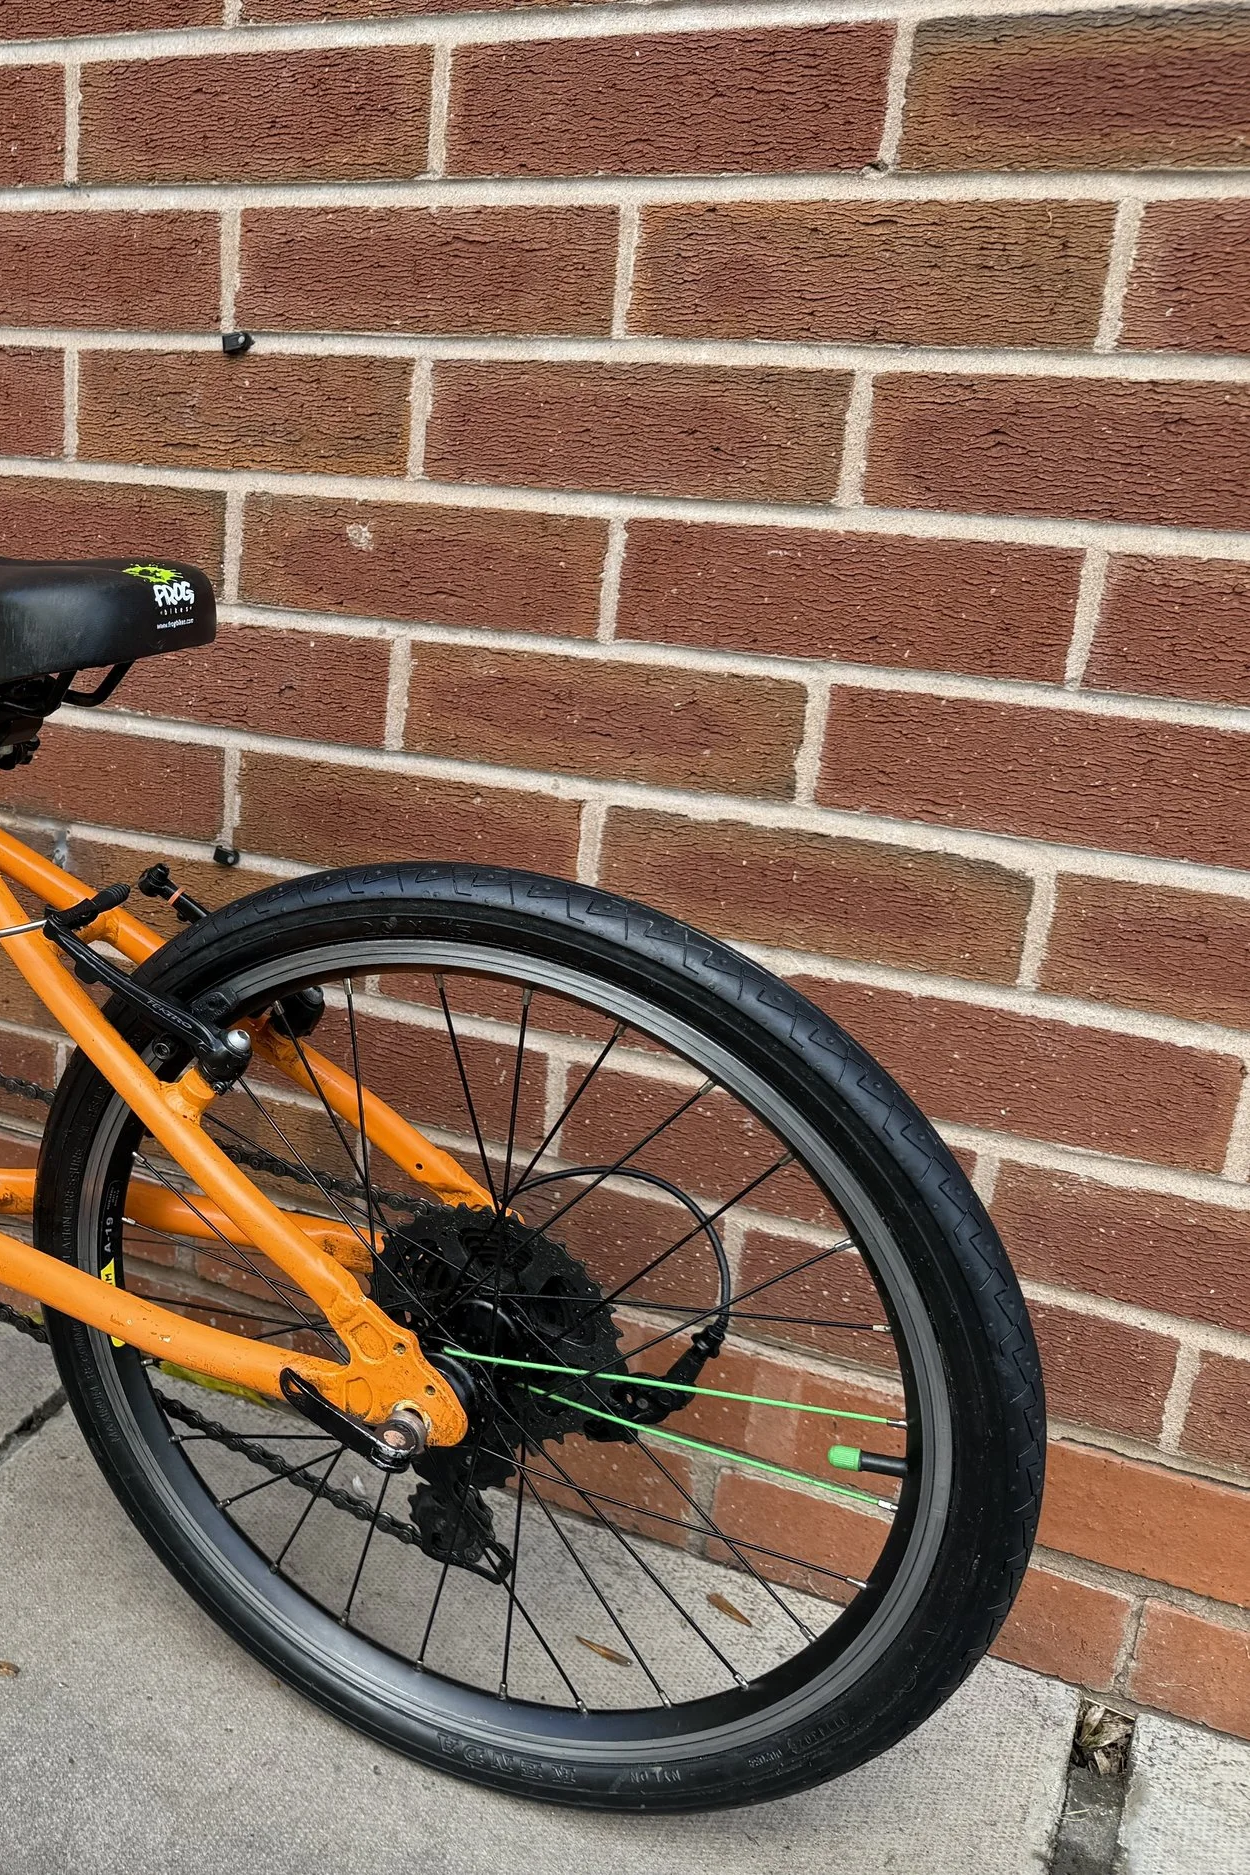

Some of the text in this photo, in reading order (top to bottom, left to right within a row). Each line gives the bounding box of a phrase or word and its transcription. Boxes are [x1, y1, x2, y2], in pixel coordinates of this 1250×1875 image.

[153, 581, 195, 606] FROG
[146, 997, 193, 1029] TEKTRO
[103, 1216, 114, 1253] A-19
[435, 1731, 577, 1785] KENDA
[630, 1766, 682, 1783] NYLON
